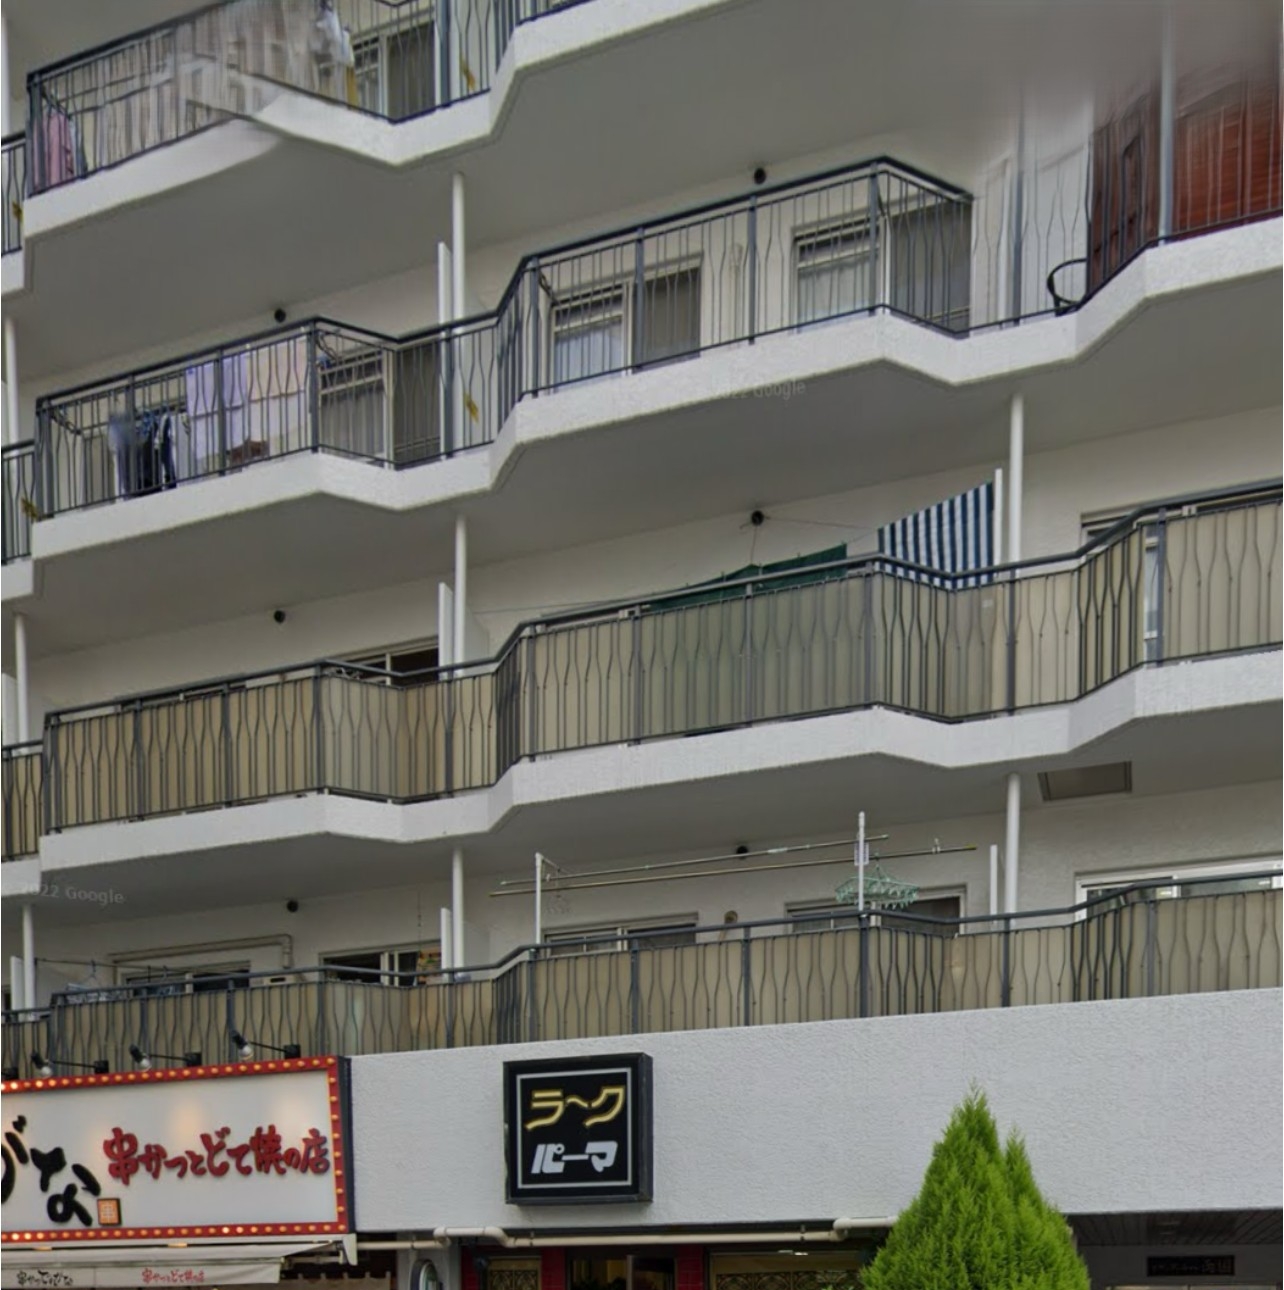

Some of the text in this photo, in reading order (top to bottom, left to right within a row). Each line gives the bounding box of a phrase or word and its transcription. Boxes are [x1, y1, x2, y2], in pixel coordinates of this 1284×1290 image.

[103, 1124, 330, 1186] 串かつとどて焼の店
[531, 1140, 618, 1174] パーマ
